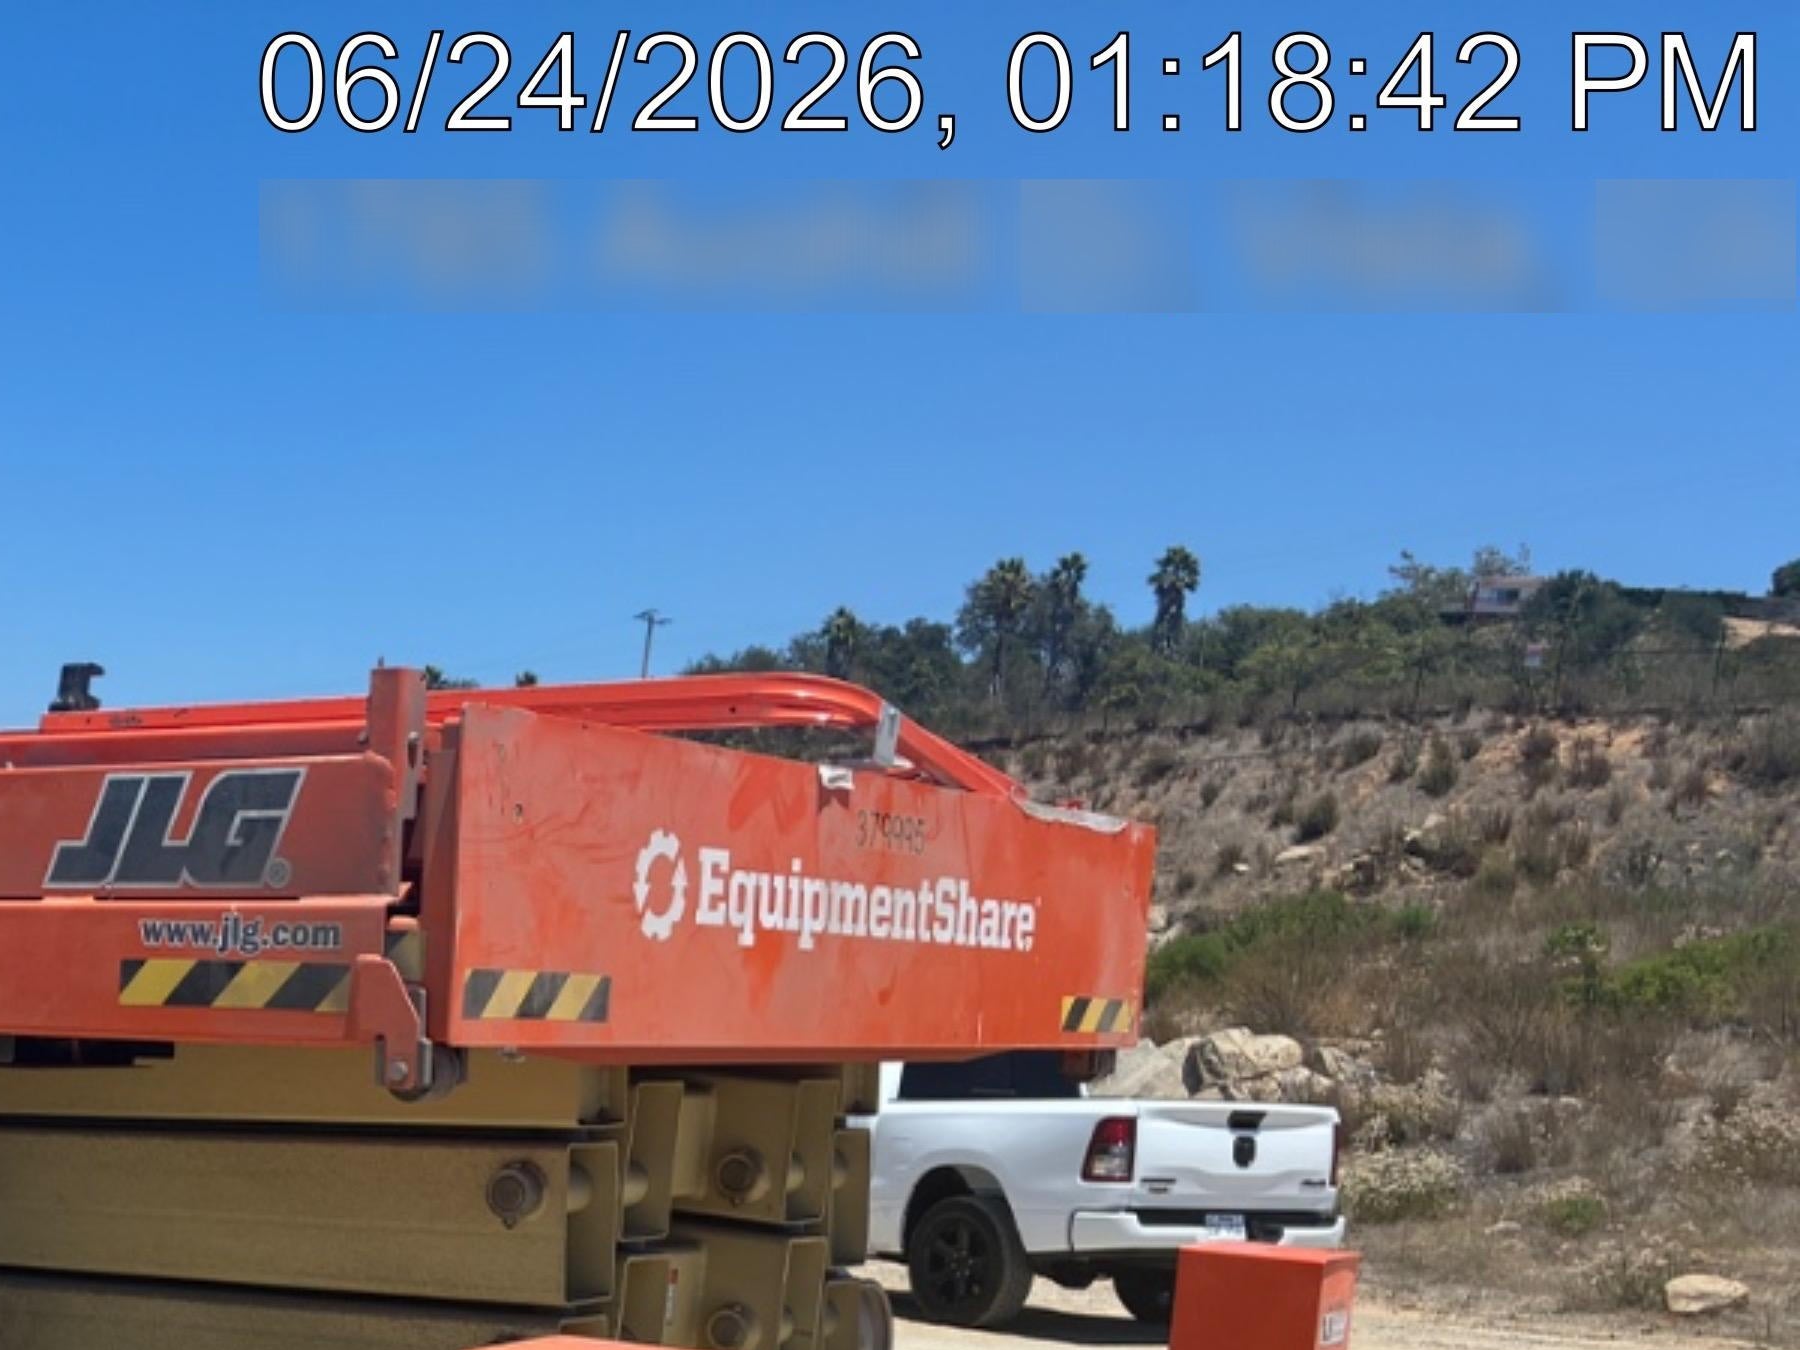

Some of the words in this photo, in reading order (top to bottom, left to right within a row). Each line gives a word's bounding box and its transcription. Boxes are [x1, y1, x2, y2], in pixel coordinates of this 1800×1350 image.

[42, 766, 308, 889] JLG
[138, 911, 343, 956] www.jlg.com
[695, 846, 1037, 951] EquipmentShare
